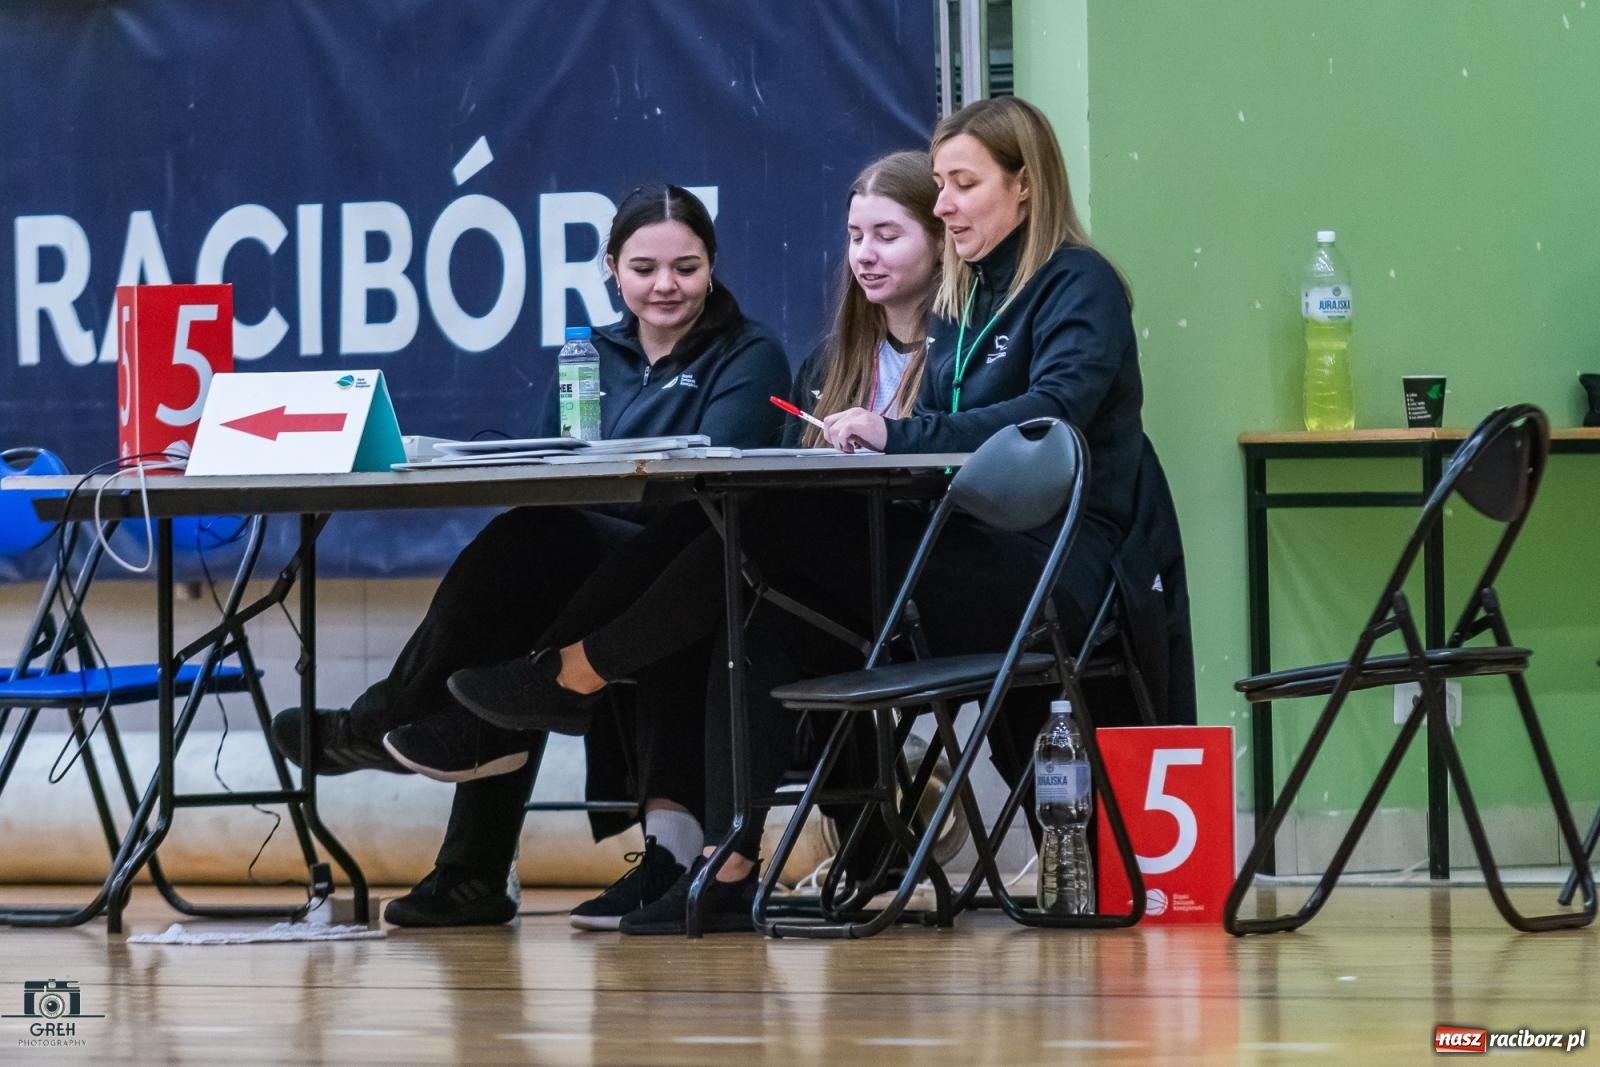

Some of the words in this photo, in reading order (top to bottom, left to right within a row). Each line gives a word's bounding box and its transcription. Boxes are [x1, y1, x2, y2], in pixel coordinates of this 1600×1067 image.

[14, 136, 719, 367] RACIBÓR
[155, 304, 219, 427] 5
[1135, 748, 1205, 875] 5
